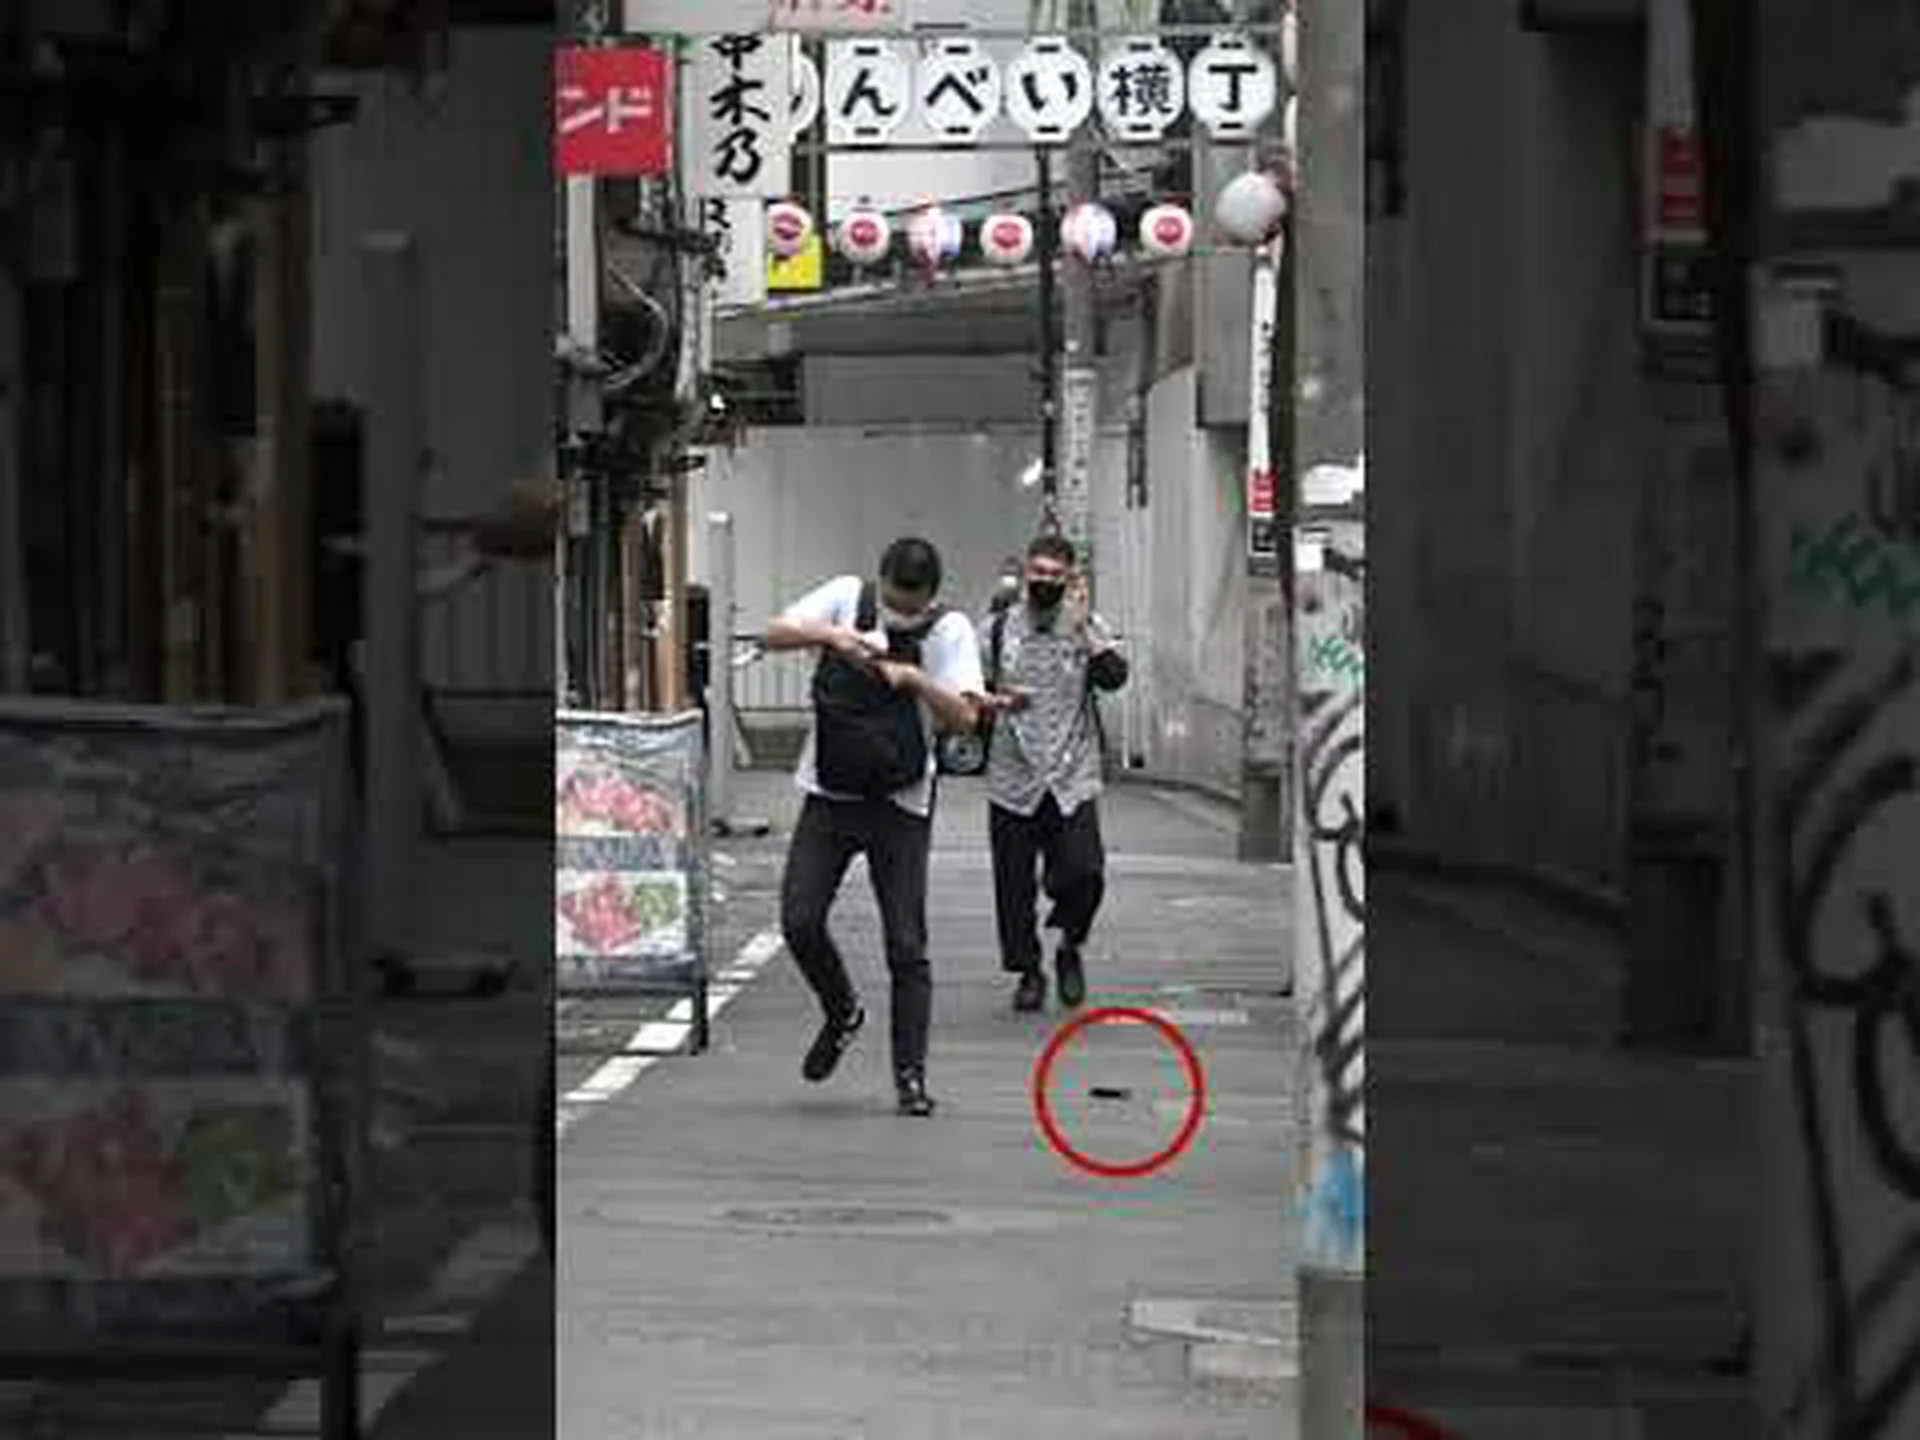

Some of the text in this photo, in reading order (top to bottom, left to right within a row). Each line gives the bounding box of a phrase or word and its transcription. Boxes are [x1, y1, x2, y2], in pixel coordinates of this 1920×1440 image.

[789, 62, 1259, 118] んべい横丁
